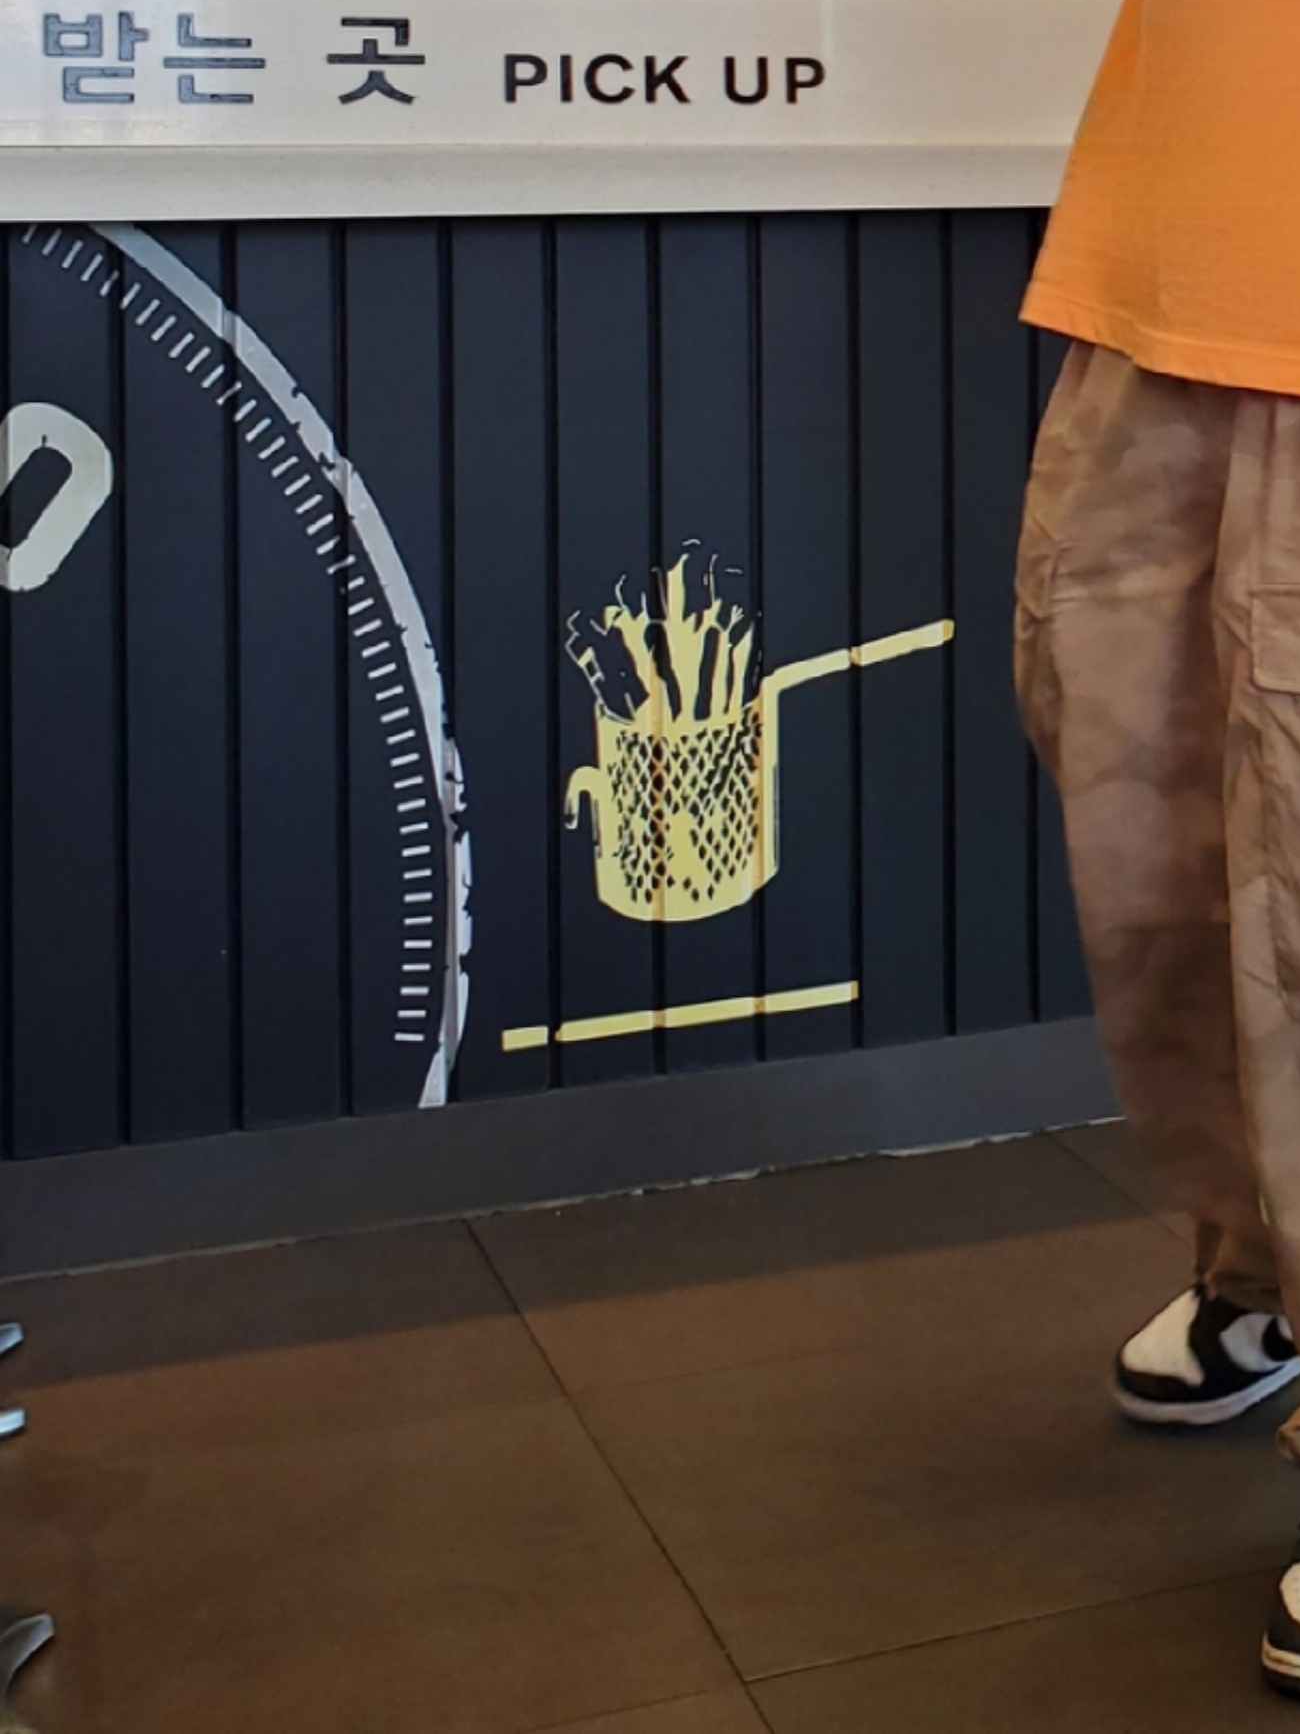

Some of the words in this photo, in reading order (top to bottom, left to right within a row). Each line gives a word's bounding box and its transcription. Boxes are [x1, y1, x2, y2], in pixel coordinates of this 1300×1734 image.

[42, 11, 268, 105] 받는
[326, 16, 426, 106] 곳
[504, 53, 690, 104] PICK
[723, 56, 826, 105] UP
